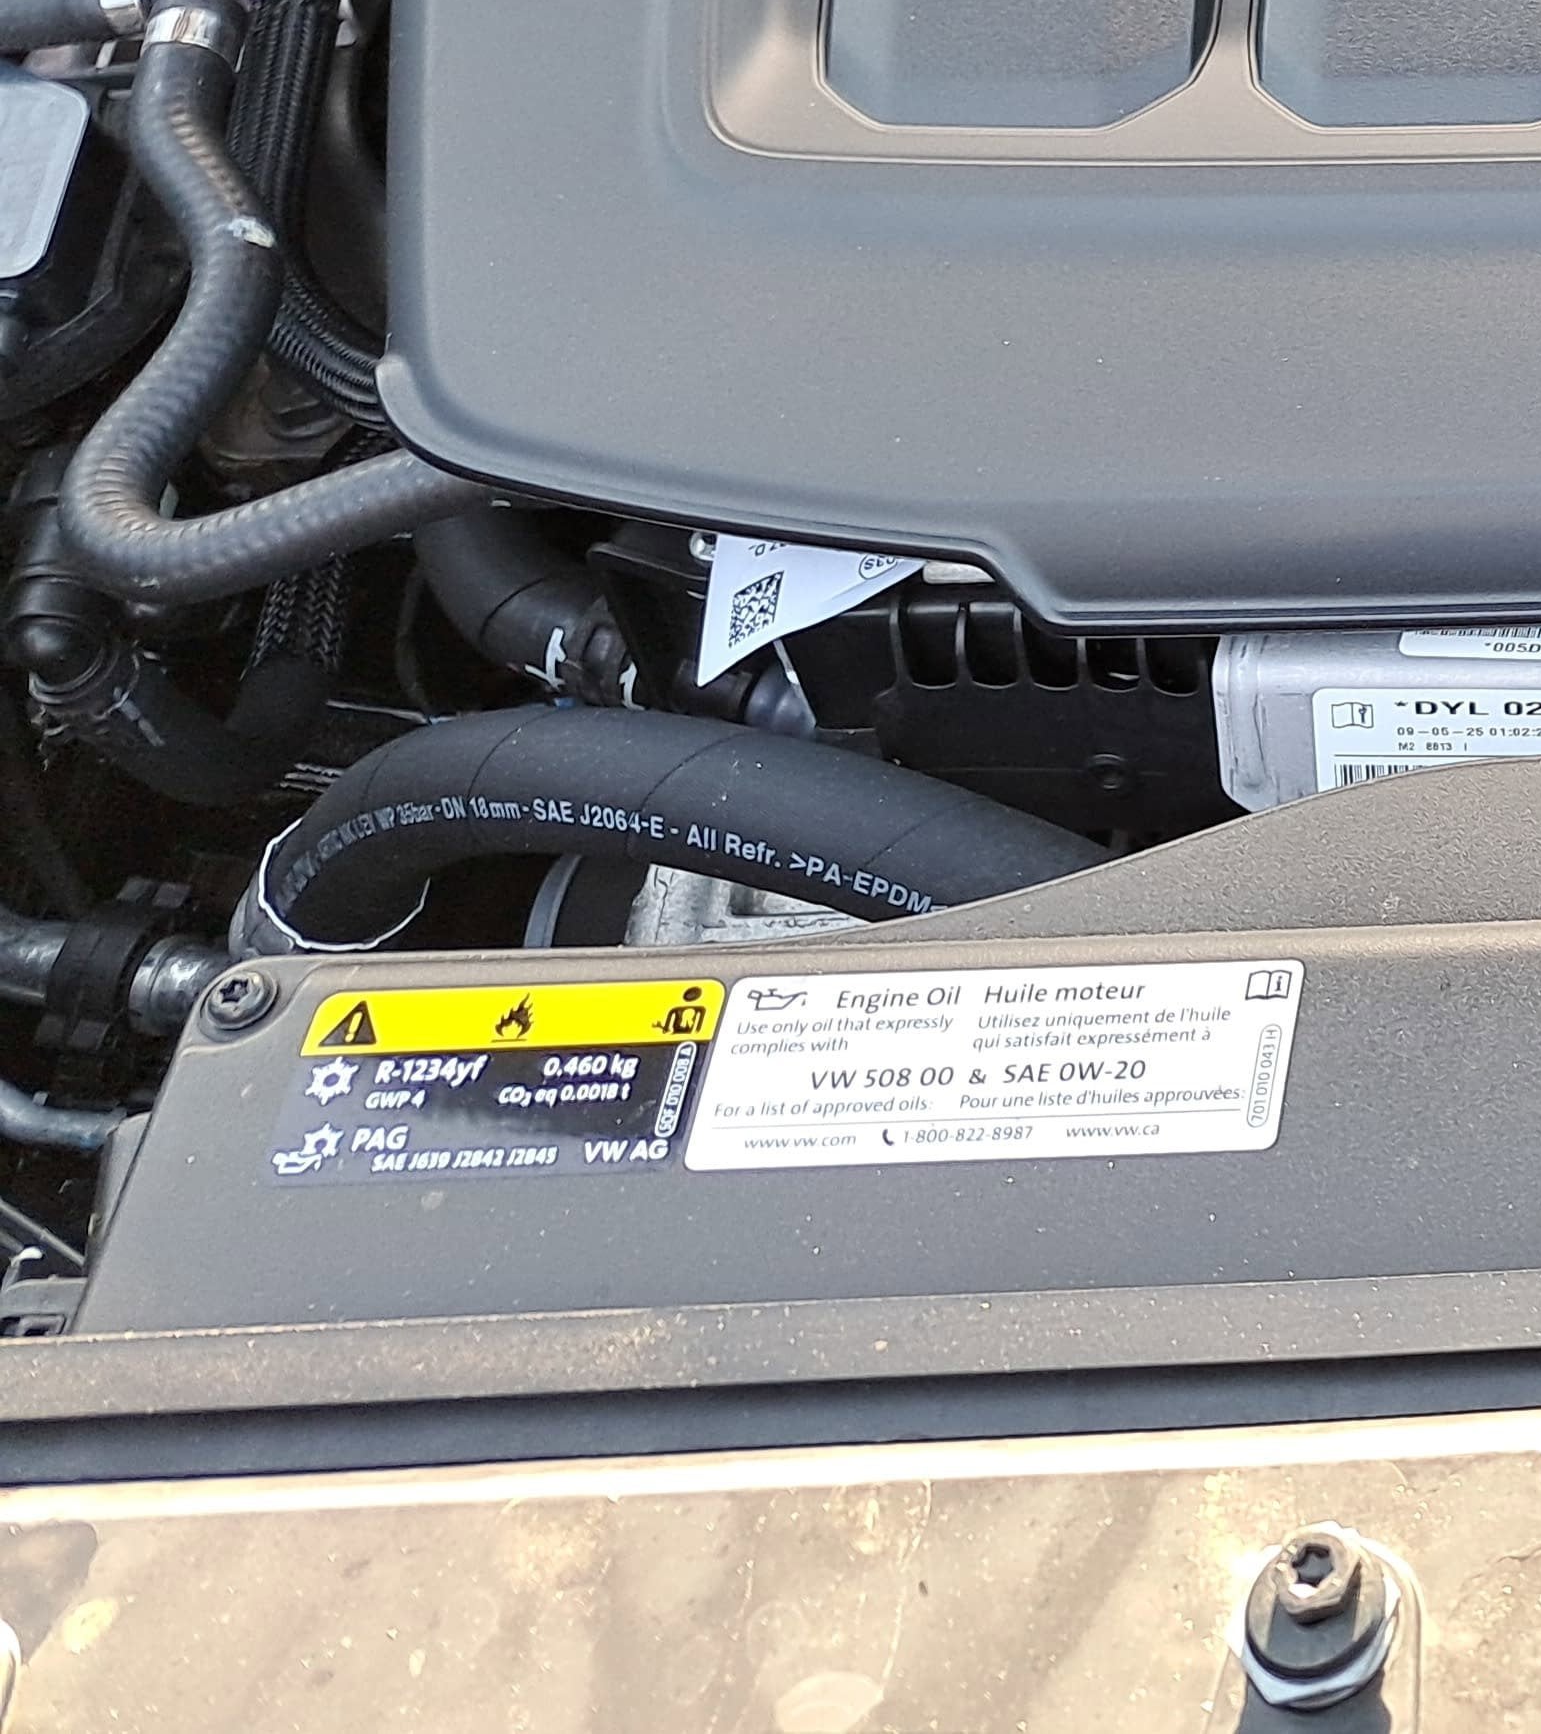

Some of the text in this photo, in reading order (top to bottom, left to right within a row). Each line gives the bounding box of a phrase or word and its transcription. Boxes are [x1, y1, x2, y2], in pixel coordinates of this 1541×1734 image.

[684, 825, 719, 850] All
[725, 832, 781, 868] Refr.
[836, 981, 1146, 1014] Engine Oil Huile moteur
[736, 1014, 954, 1036] Use only oil that expressly
[978, 1005, 1231, 1030] Utilisez uniquement de l'huile
[730, 1037, 849, 1058] complies with
[973, 1028, 1212, 1052] qui satisfait expressément à
[374, 1055, 638, 1087] R-1234yf 0.460 kg
[811, 1059, 1147, 1091] VW 508 00 & SAE 0W-20
[1251, 1029, 1277, 1121] 701 010 043 H
[365, 1092, 410, 1109] GWP
[411, 1089, 425, 1108] 4
[714, 1096, 933, 1118] For a list of approved oils:
[960, 1085, 1247, 1110] Pour une liste d'huiles approuvées:
[351, 1126, 409, 1152] PAG
[744, 1122, 1161, 1150] www.vw.com 1-800-822-8987 www.vw.ca
[371, 1153, 404, 1173] SAE
[584, 1140, 669, 1163] VW AG
